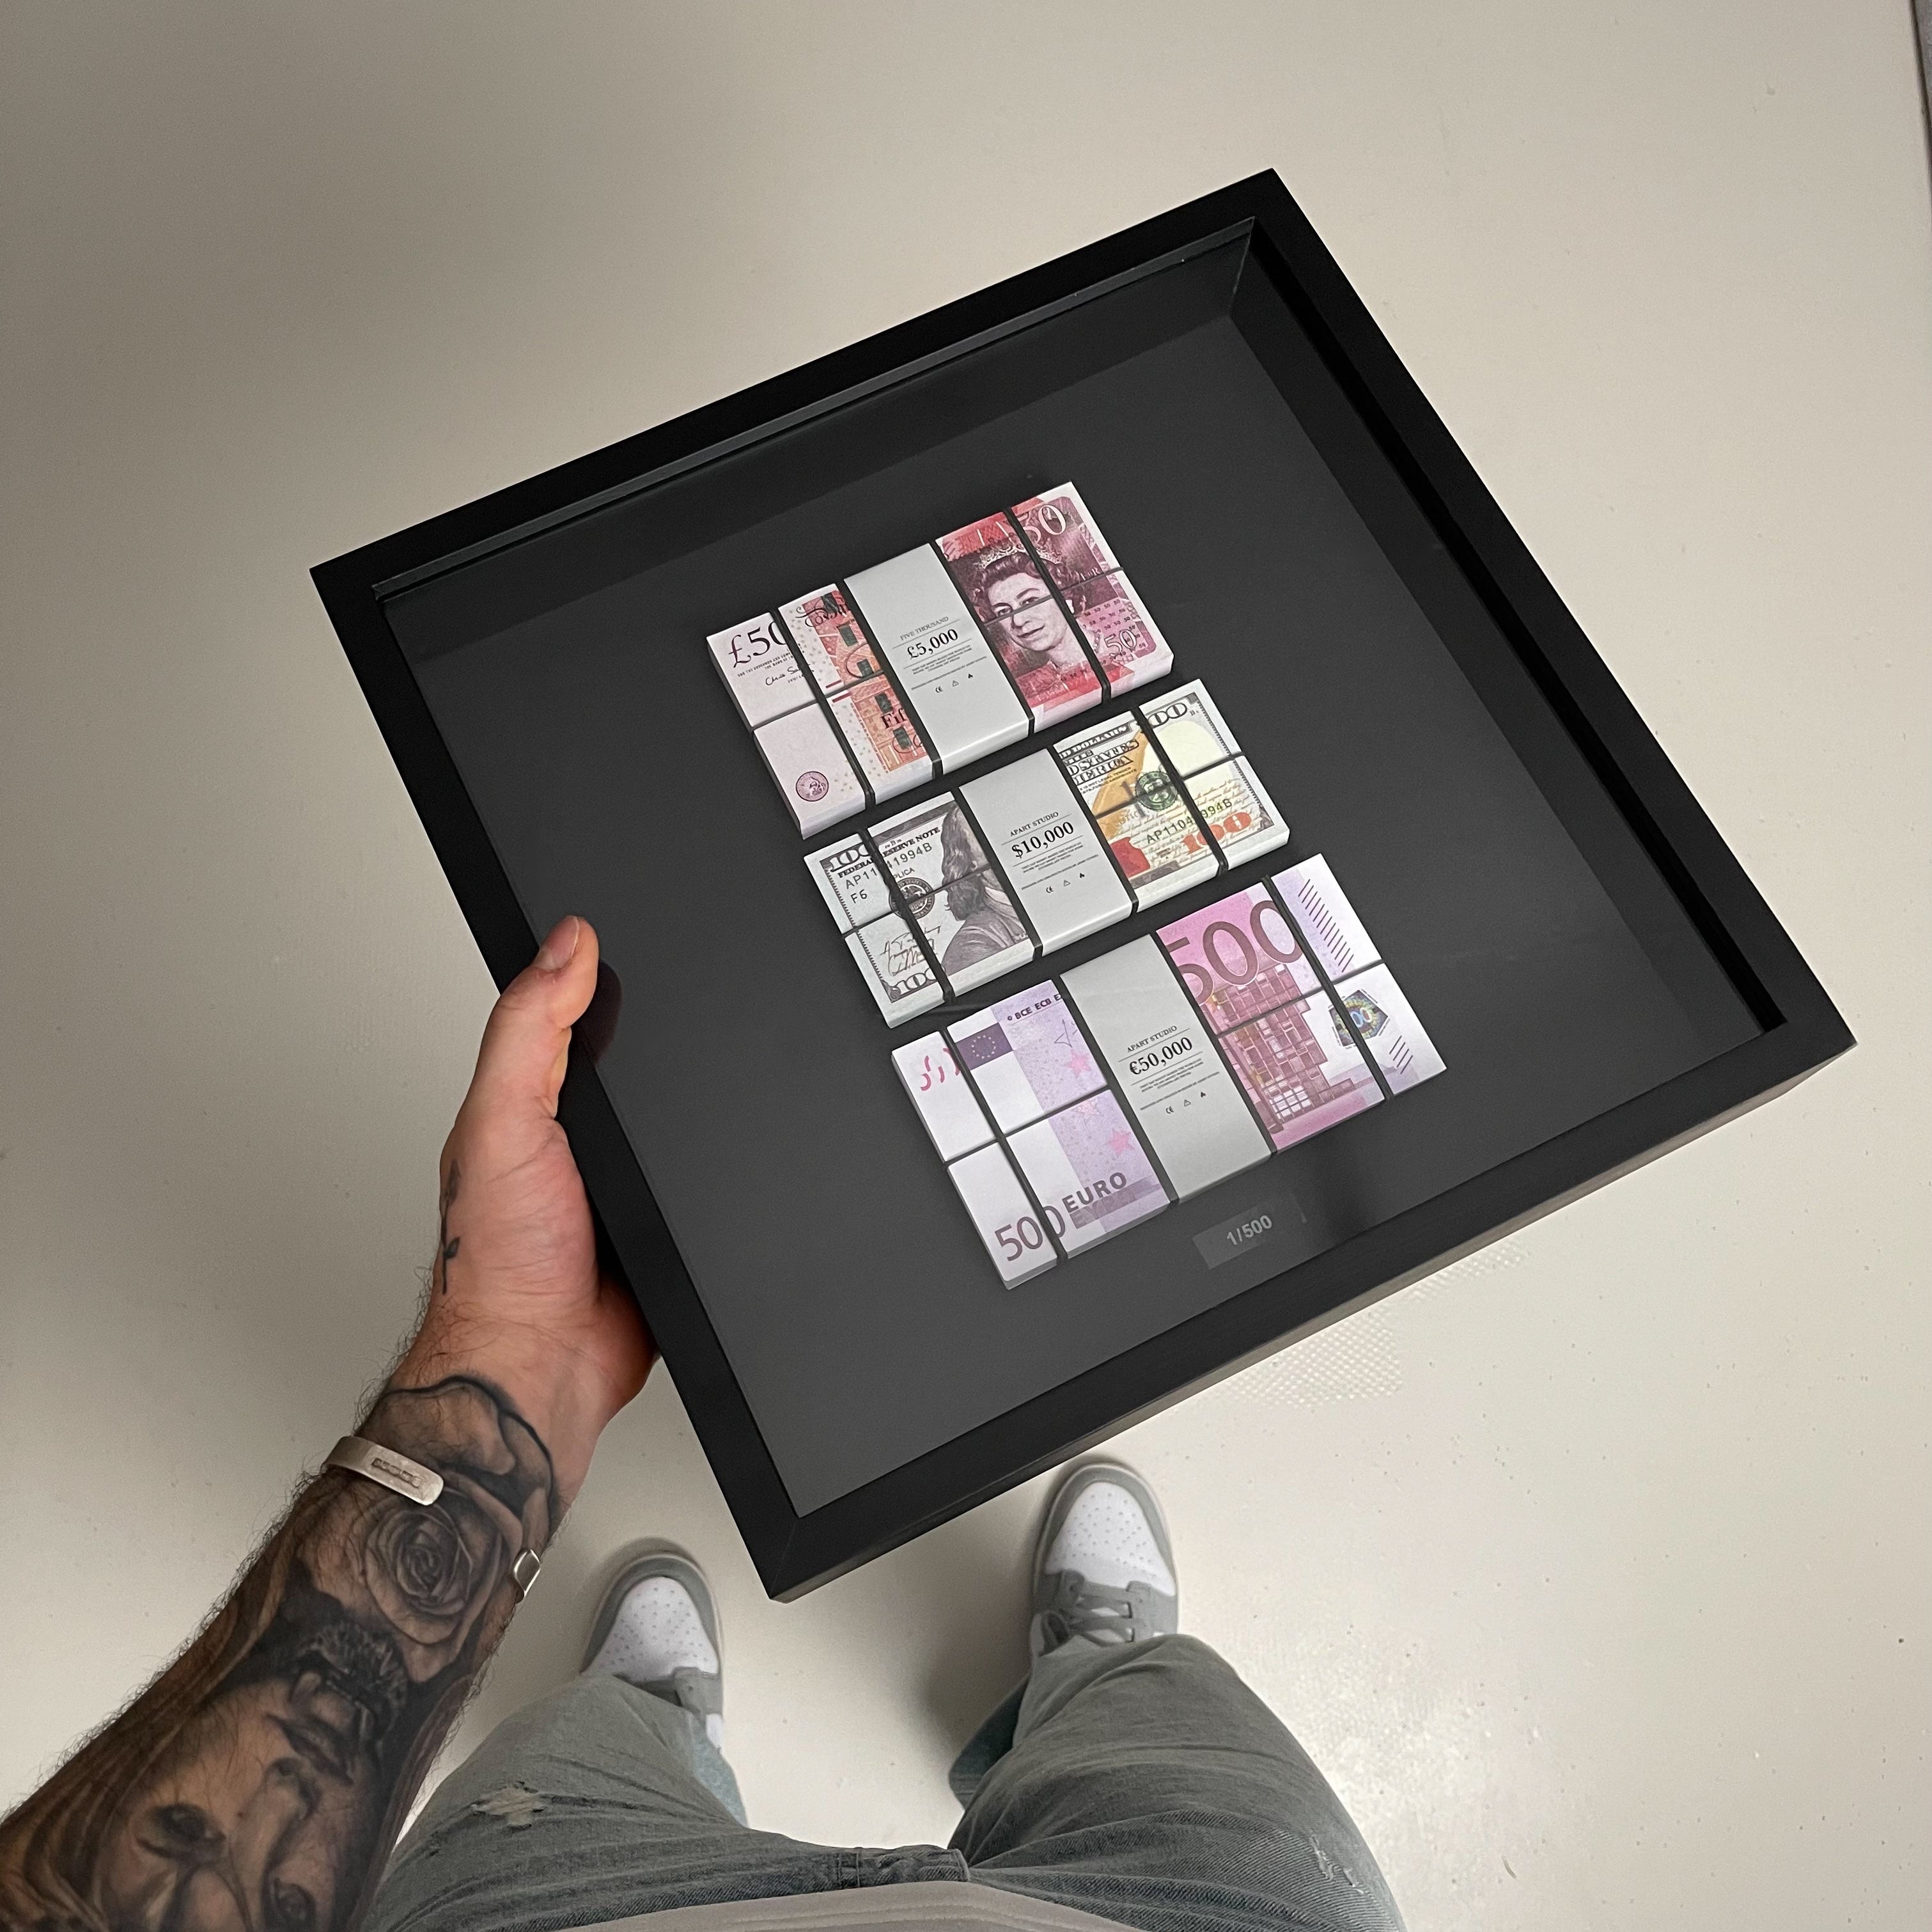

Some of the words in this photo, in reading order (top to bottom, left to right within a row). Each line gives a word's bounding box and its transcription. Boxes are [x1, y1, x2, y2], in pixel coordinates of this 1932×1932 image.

[900, 631, 915, 641] FIVE
[915, 616, 949, 634] THOUSAND
[907, 628, 958, 660] £5,000
[1010, 823, 1031, 837] APART
[1032, 811, 1059, 827] STUDIO
[837, 857, 874, 878] FEDERA
[914, 826, 940, 842] NOTE
[1011, 822, 1074, 859] $10,000
[850, 888, 868, 903] F6
[1165, 900, 1304, 1006] 500
[1014, 1006, 1033, 1020] BCE
[1034, 997, 1052, 1011] ECB
[1126, 1038, 1149, 1053] APART
[1150, 1025, 1178, 1042] STUDIO
[1129, 1037, 1192, 1075] €50,000
[1061, 1170, 1129, 1213] EURO
[1226, 1215, 1272, 1245] 1/500
